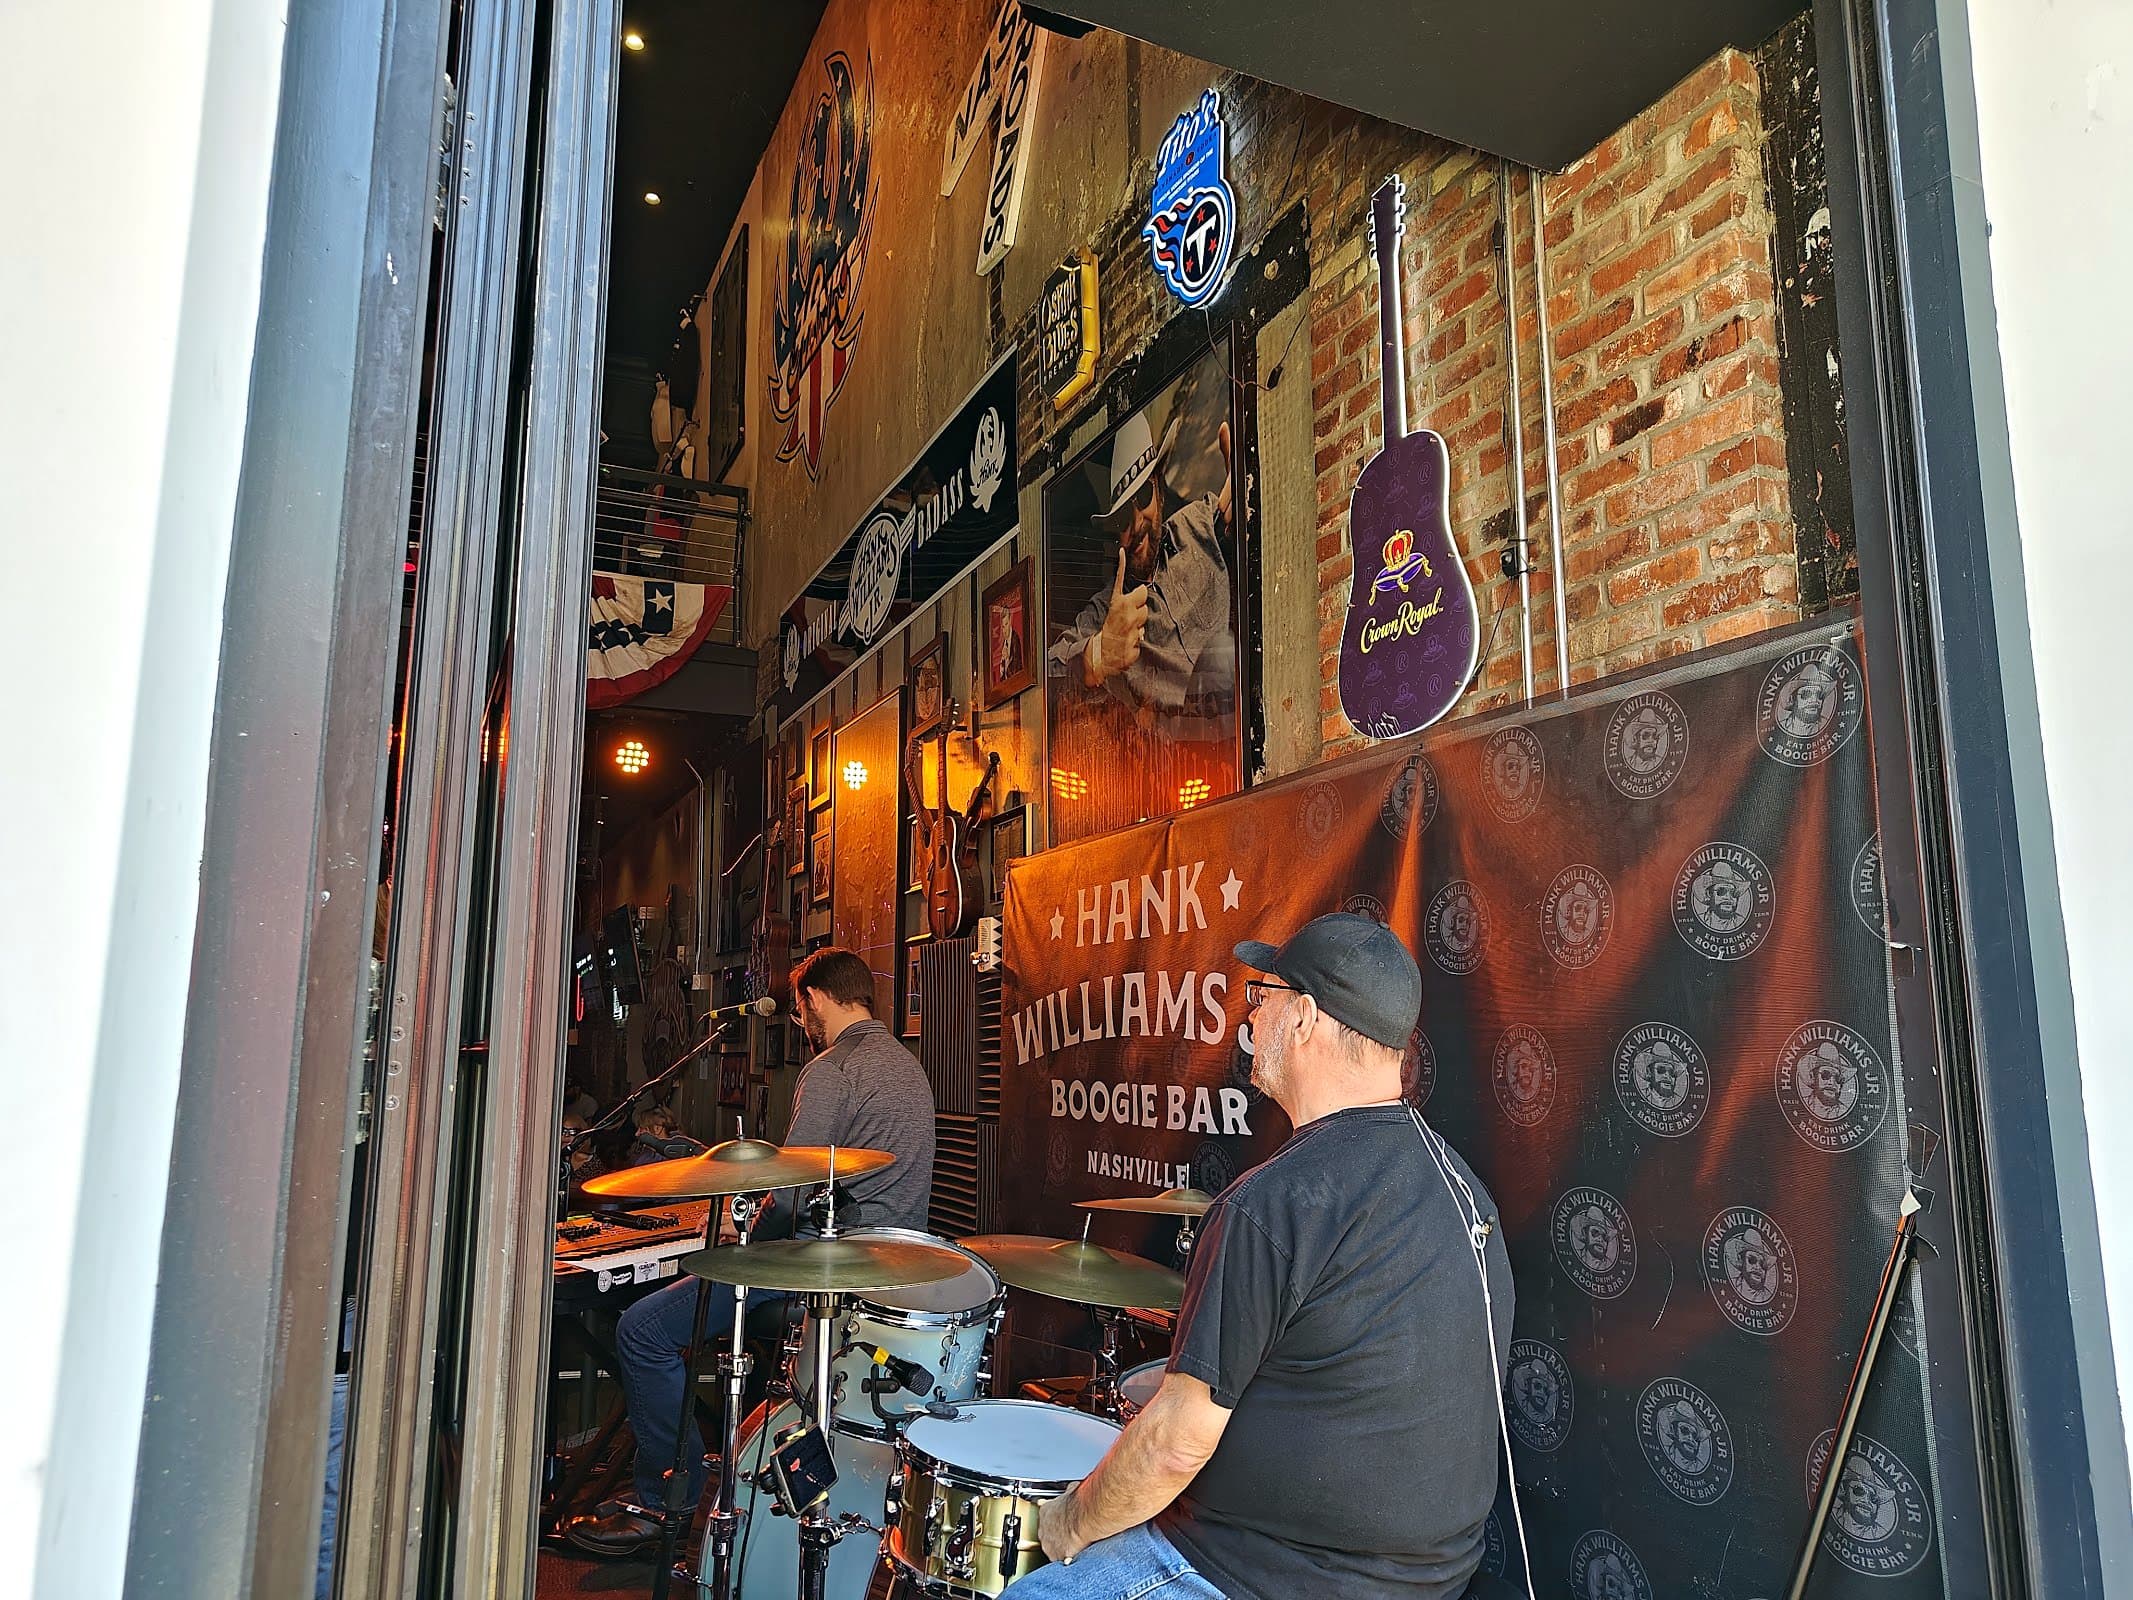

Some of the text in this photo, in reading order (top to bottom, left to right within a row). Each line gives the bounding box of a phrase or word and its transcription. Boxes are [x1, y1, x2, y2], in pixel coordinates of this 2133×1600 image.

[1157, 93, 1215, 179] Tito's
[1043, 343, 1079, 386] BREWERY
[917, 467, 963, 549] BADASS
[803, 600, 837, 660] ORIGINAL
[1360, 586, 1443, 654] Crown Royal
[1762, 650, 1856, 721] HANK WILLIAMS JR
[1494, 729, 1536, 755] WILLIAMS
[1532, 757, 1540, 773] JR
[1610, 695, 1683, 757] HANK WILLIAMS JR
[1774, 732, 1842, 760] BOOGIE BAR
[1621, 769, 1674, 794] BOOGIE BAR
[1076, 860, 1208, 948] HANK
[1545, 869, 1610, 924] HANK WILLIAMS JR
[1677, 847, 1769, 911] HANK WILLIAMS JR
[1429, 897, 1446, 934] HANK
[1739, 931, 1760, 951] BAR
[1438, 954, 1467, 970] BOOGIE
[1584, 943, 1600, 961] BAR
[1011, 970, 1228, 1066] WILLIAMS
[1423, 1059, 1432, 1075] JR
[1508, 1028, 1549, 1060] WILLIAMS
[1544, 1063, 1552, 1081] JR
[1619, 1027, 1705, 1086] HANK WILLIAMS JR
[1781, 1026, 1881, 1095] HANK WILLIAMS JR
[1050, 1079, 1253, 1136] BOOGIE BAR
[1637, 1110, 1695, 1132] BOOGIE BAR
[1799, 1121, 1866, 1146] BOOGIE BAR
[1087, 1150, 1187, 1189] NASHVILLE
[1556, 1192, 1631, 1253] HANK WILLIAMS JR
[1708, 1212, 1793, 1284] HANK WILLIAMS JR
[1572, 1269, 1624, 1294] BOOGIE BAR
[1724, 1300, 1785, 1329] BOOGIE BAR
[1513, 1344, 1568, 1386] WILLIAMS
[1562, 1390, 1570, 1410] JR
[1642, 1383, 1728, 1459] HANK WILLIAMS JR
[1660, 1466, 1717, 1499] BOOGIE BAR
[1904, 1498, 1922, 1523] JR
[1576, 1536, 1645, 1588] HANK WILLIAMS
[1879, 1551, 1909, 1569] BAR
